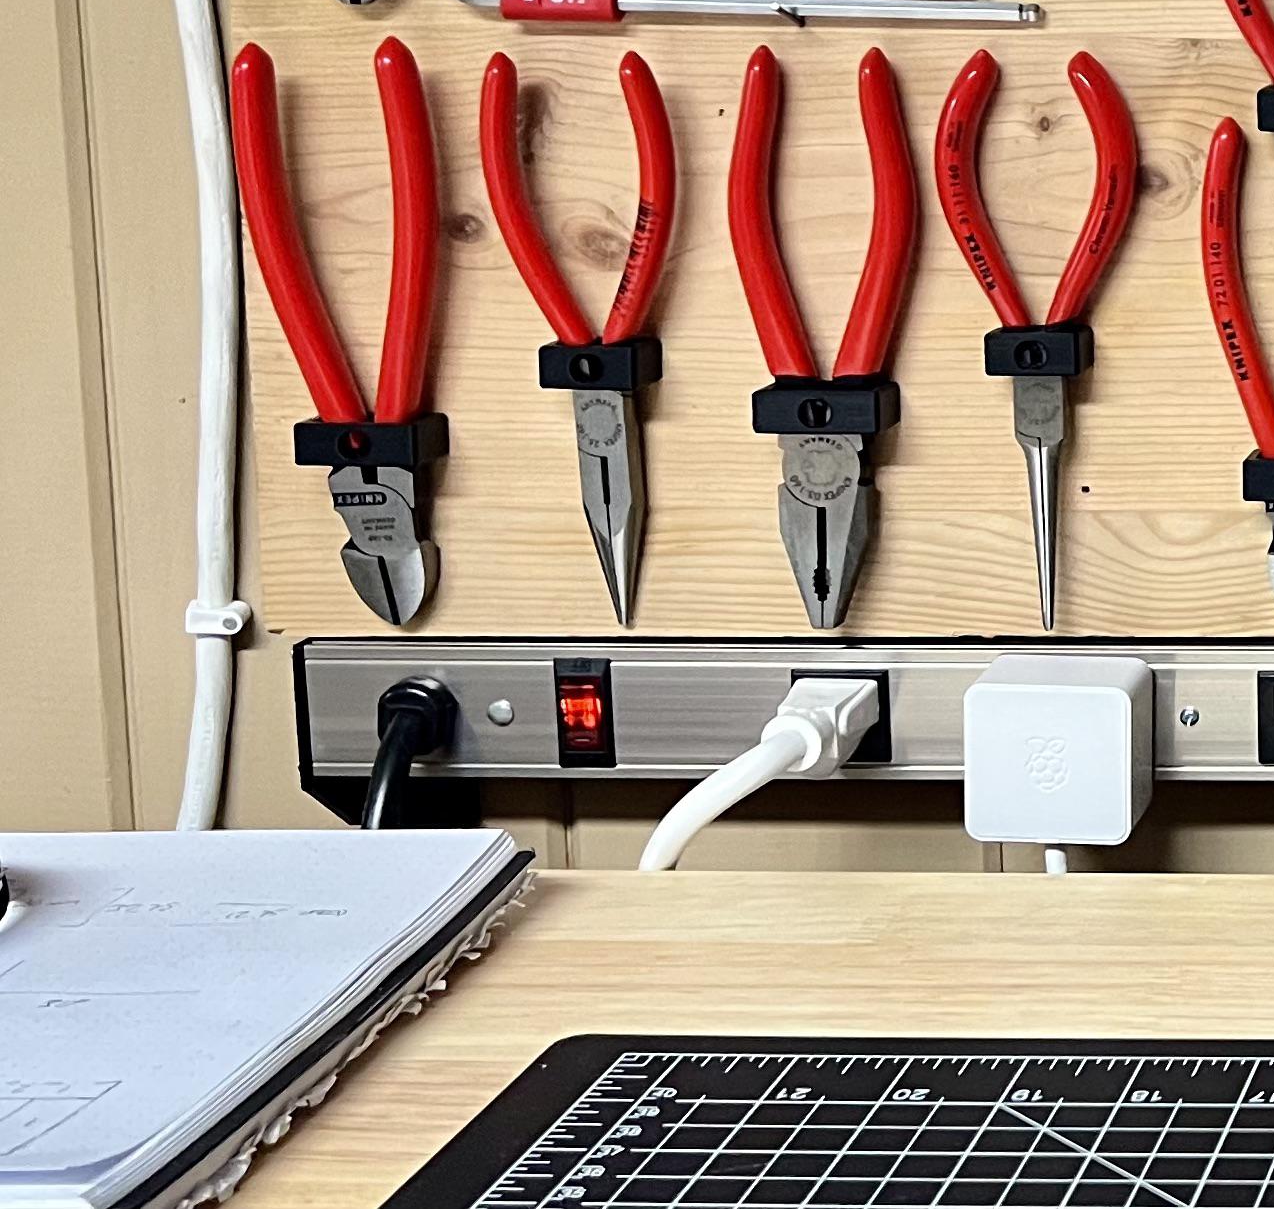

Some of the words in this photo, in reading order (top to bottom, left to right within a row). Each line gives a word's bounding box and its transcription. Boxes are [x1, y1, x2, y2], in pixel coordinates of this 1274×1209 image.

[1209, 241, 1223, 266] 140
[963, 231, 996, 291] KNIPEX
[1212, 272, 1226, 287] 01
[1215, 291, 1229, 307] 72
[1221, 319, 1250, 382] KNIPEX
[336, 493, 384, 505] KNIPEX
[777, 1088, 812, 1100] 21
[892, 1088, 930, 1100] 20
[1010, 1090, 1043, 1102] 19
[1130, 1090, 1162, 1102] 18
